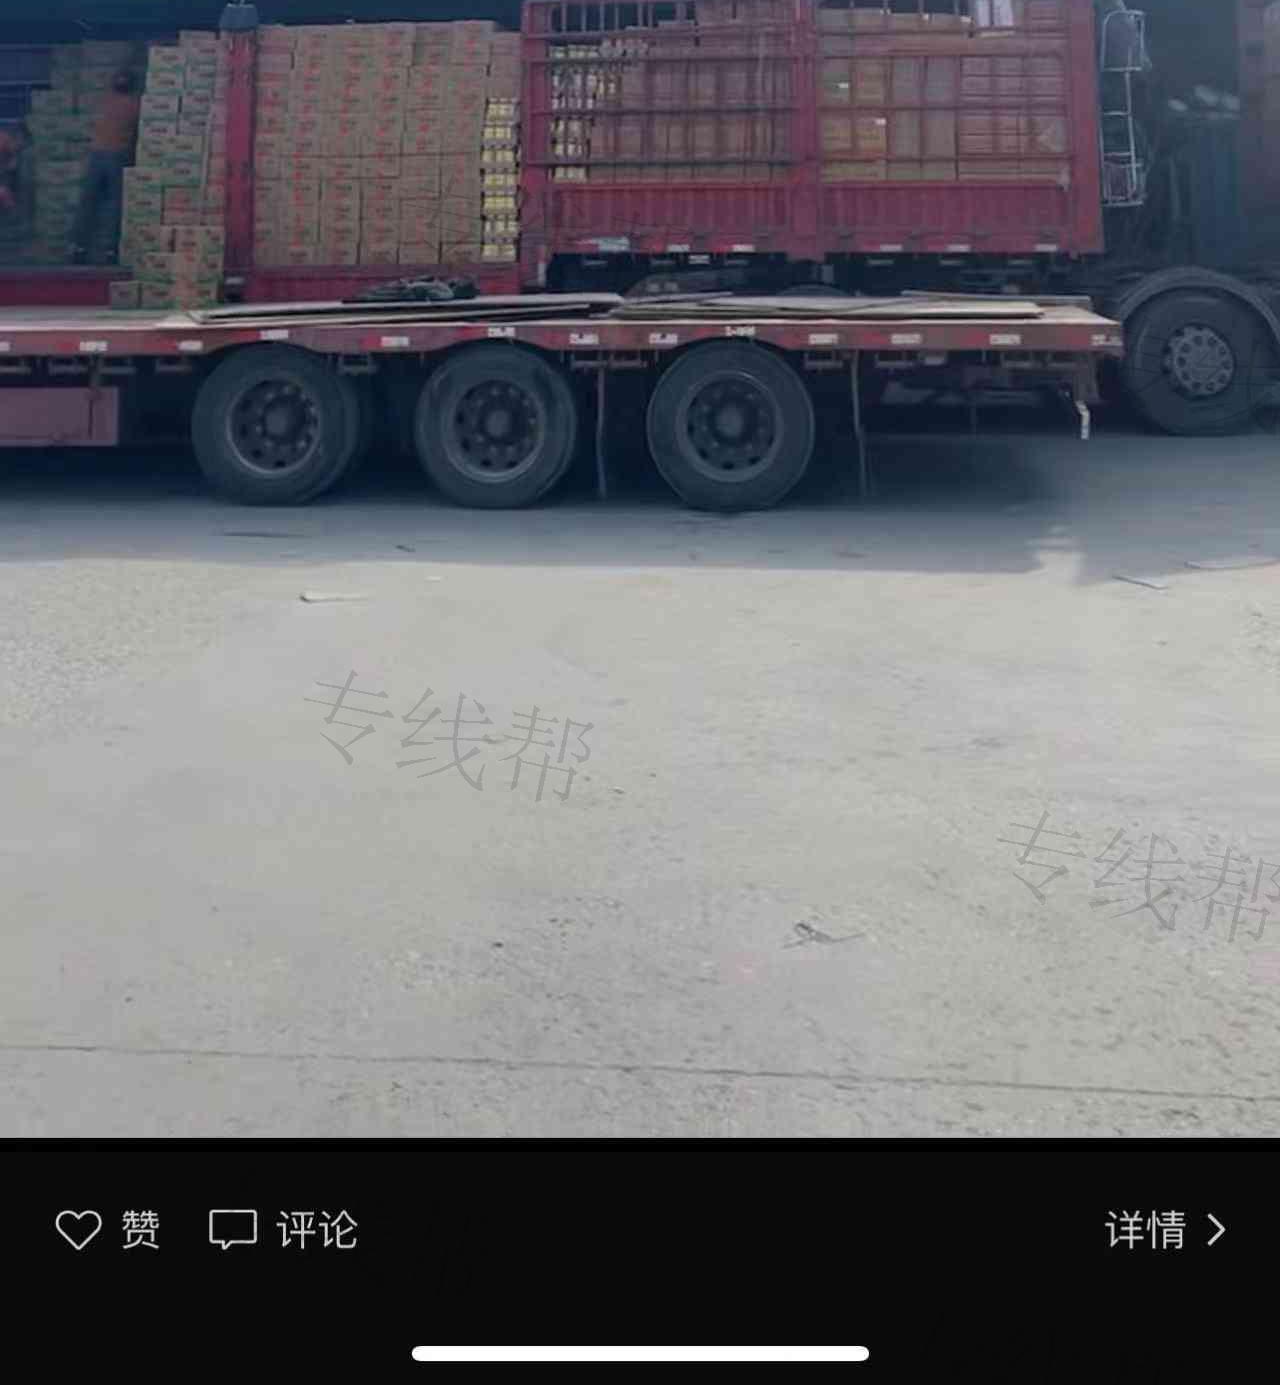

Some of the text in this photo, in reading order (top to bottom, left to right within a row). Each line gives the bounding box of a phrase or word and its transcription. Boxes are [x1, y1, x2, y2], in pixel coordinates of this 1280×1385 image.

[121, 1210, 160, 1249] 赞
[276, 1209, 358, 1249] 评论
[1104, 1209, 1187, 1249] 详情
